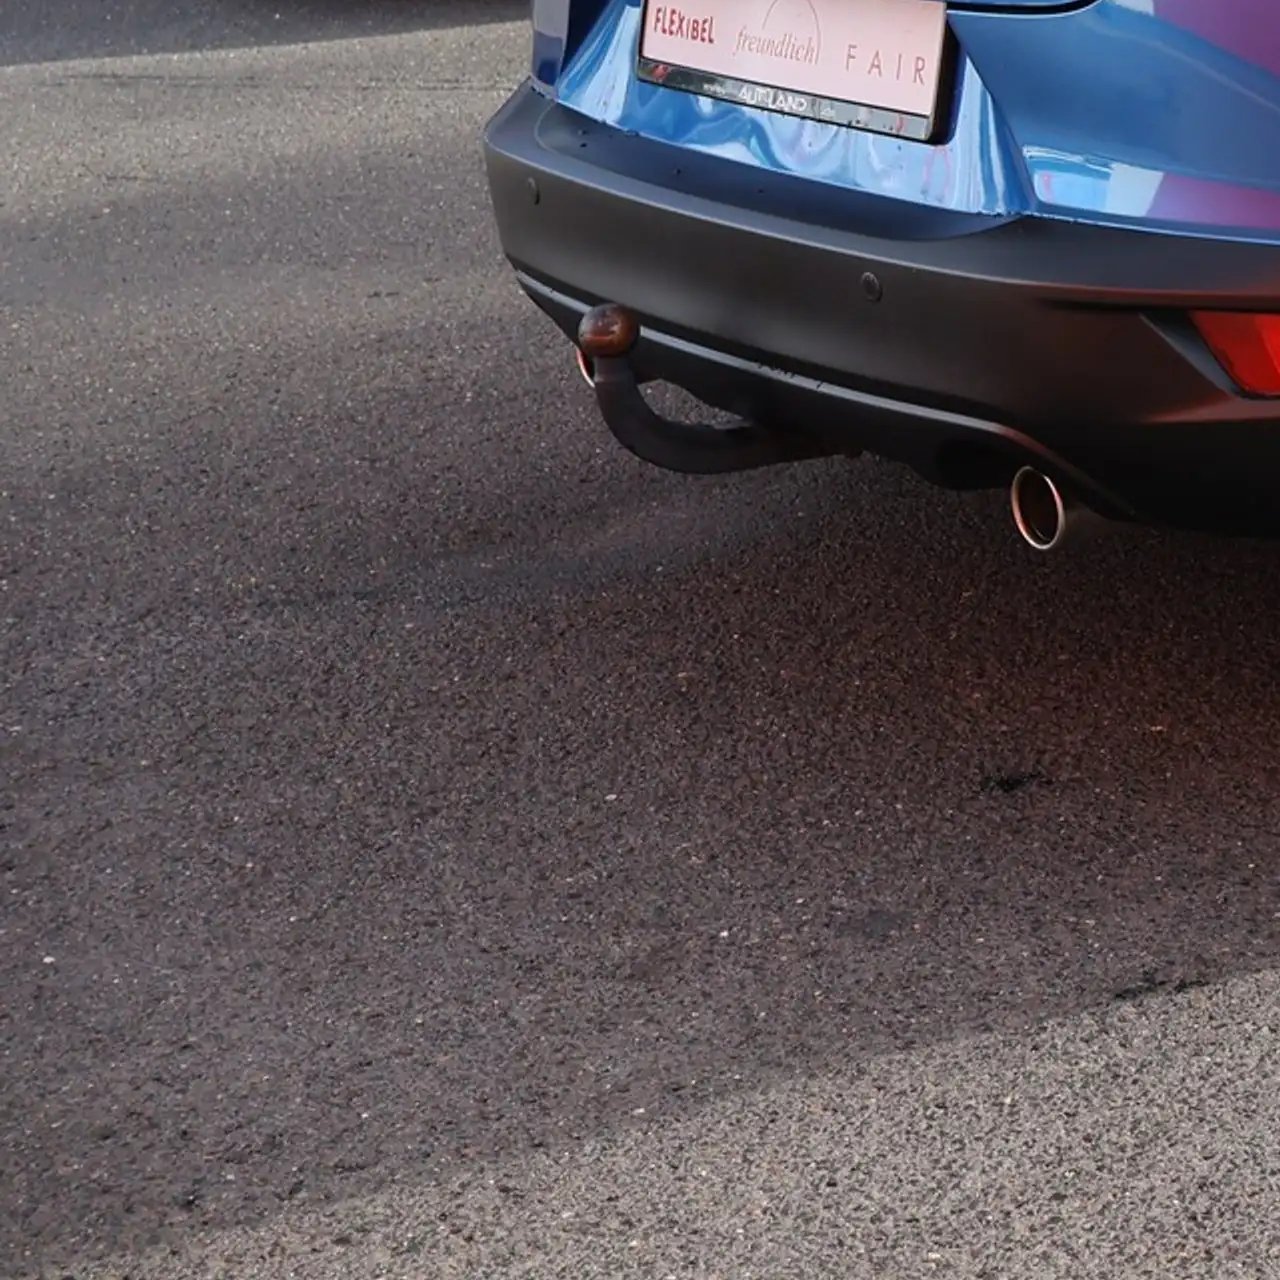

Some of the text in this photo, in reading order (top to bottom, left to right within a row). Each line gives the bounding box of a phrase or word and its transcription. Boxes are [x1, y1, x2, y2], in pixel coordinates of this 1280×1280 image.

[653, 5, 926, 86] FLEXIBEL freundlich FAIR
